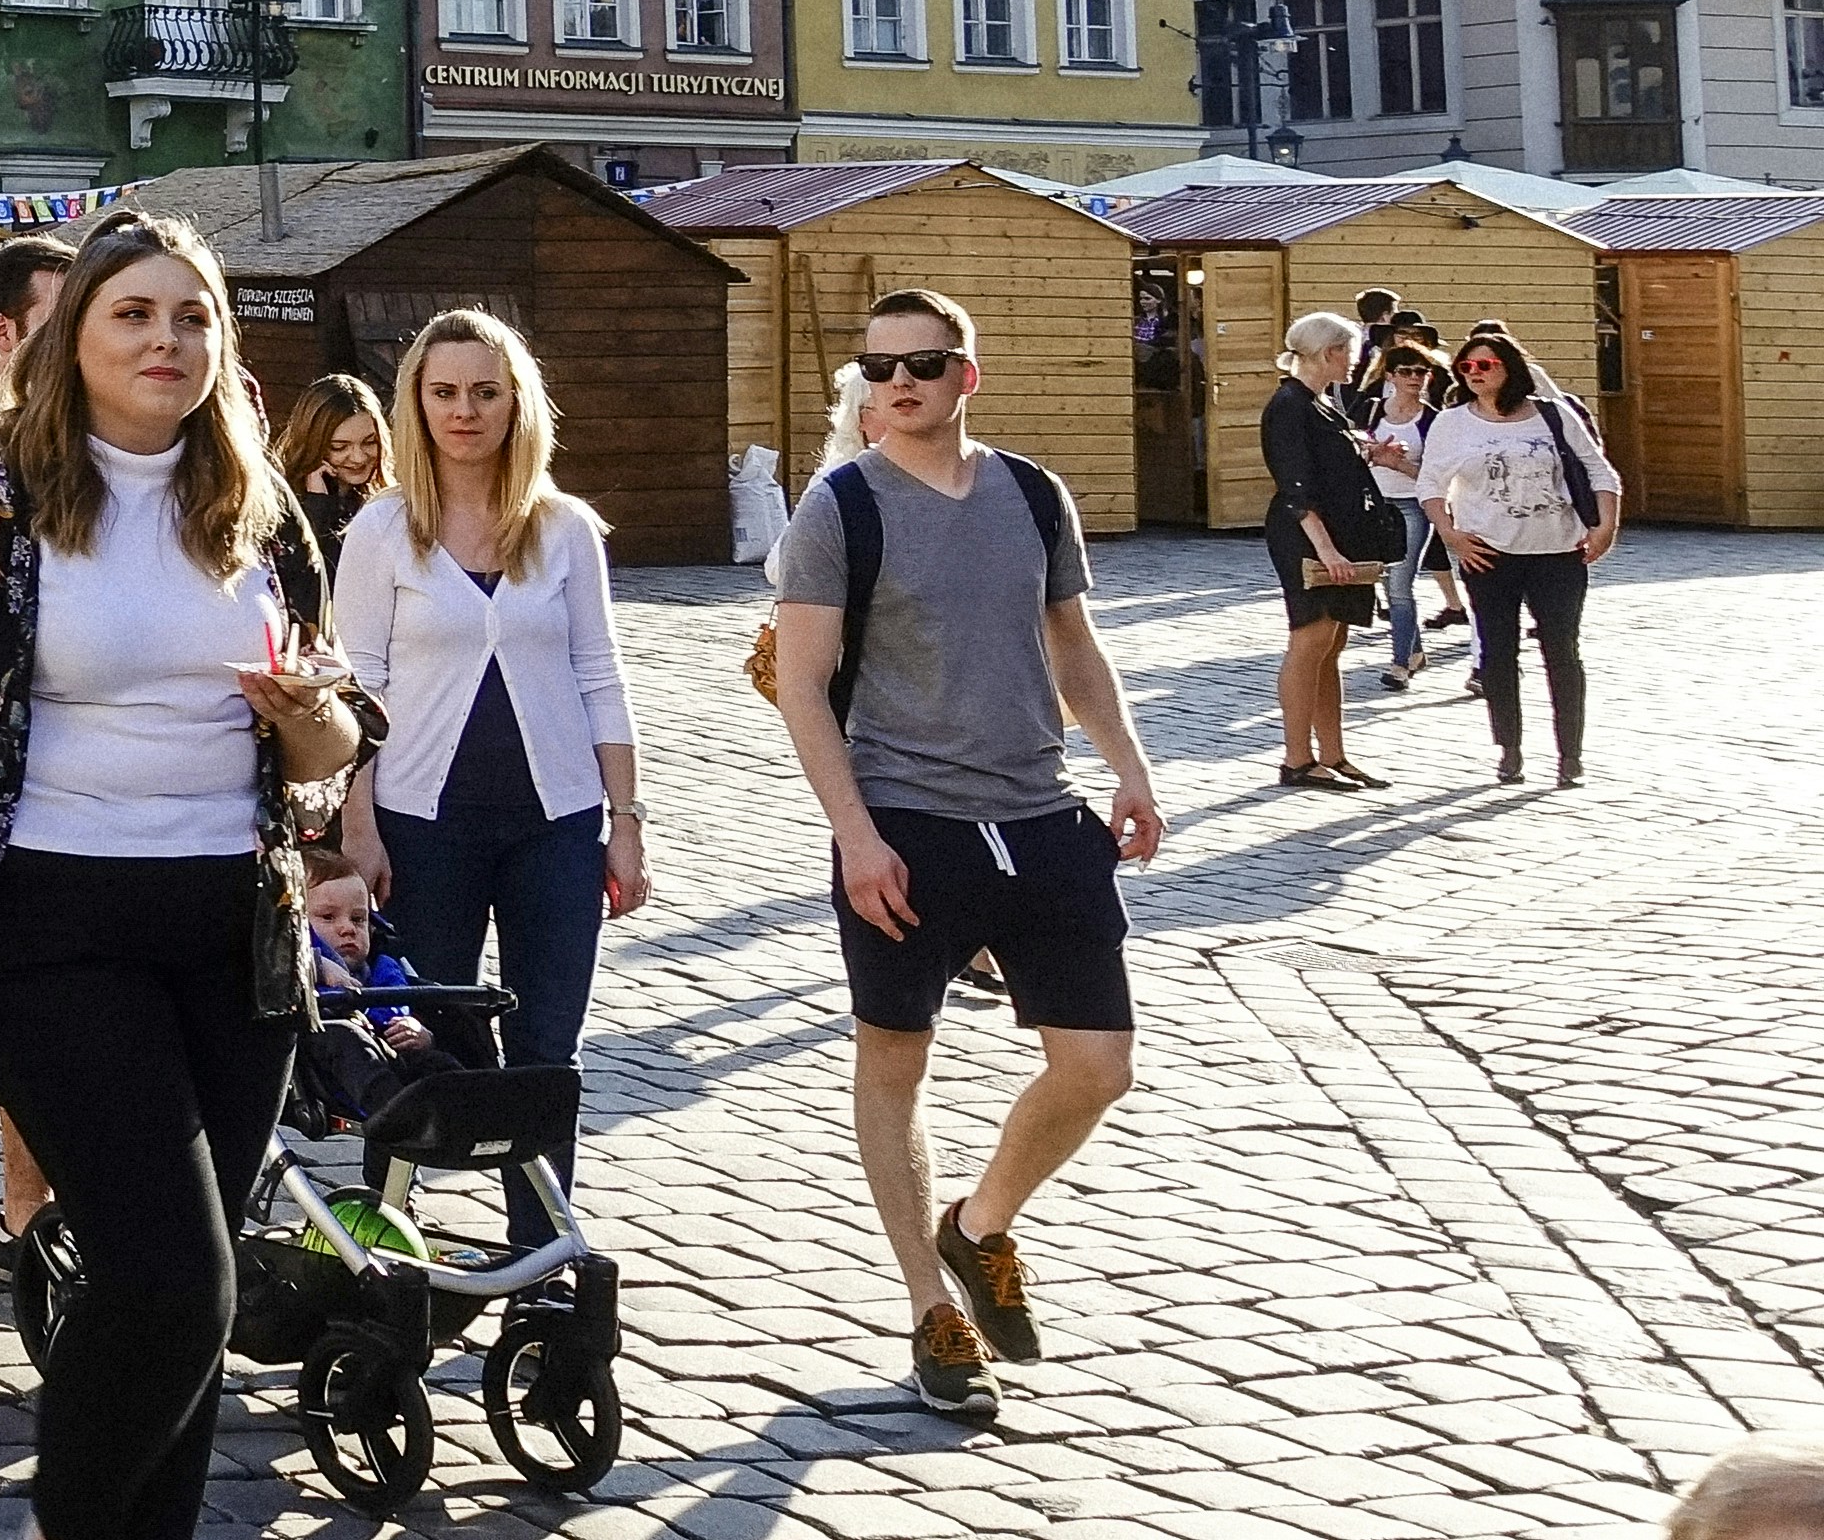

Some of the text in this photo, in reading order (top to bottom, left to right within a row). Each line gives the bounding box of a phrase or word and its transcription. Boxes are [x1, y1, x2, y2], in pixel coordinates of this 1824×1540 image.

[425, 64, 785, 101] CENTRUM INFORMACJI TURYSTYCZNEJ
[237, 304, 243, 316] Z
